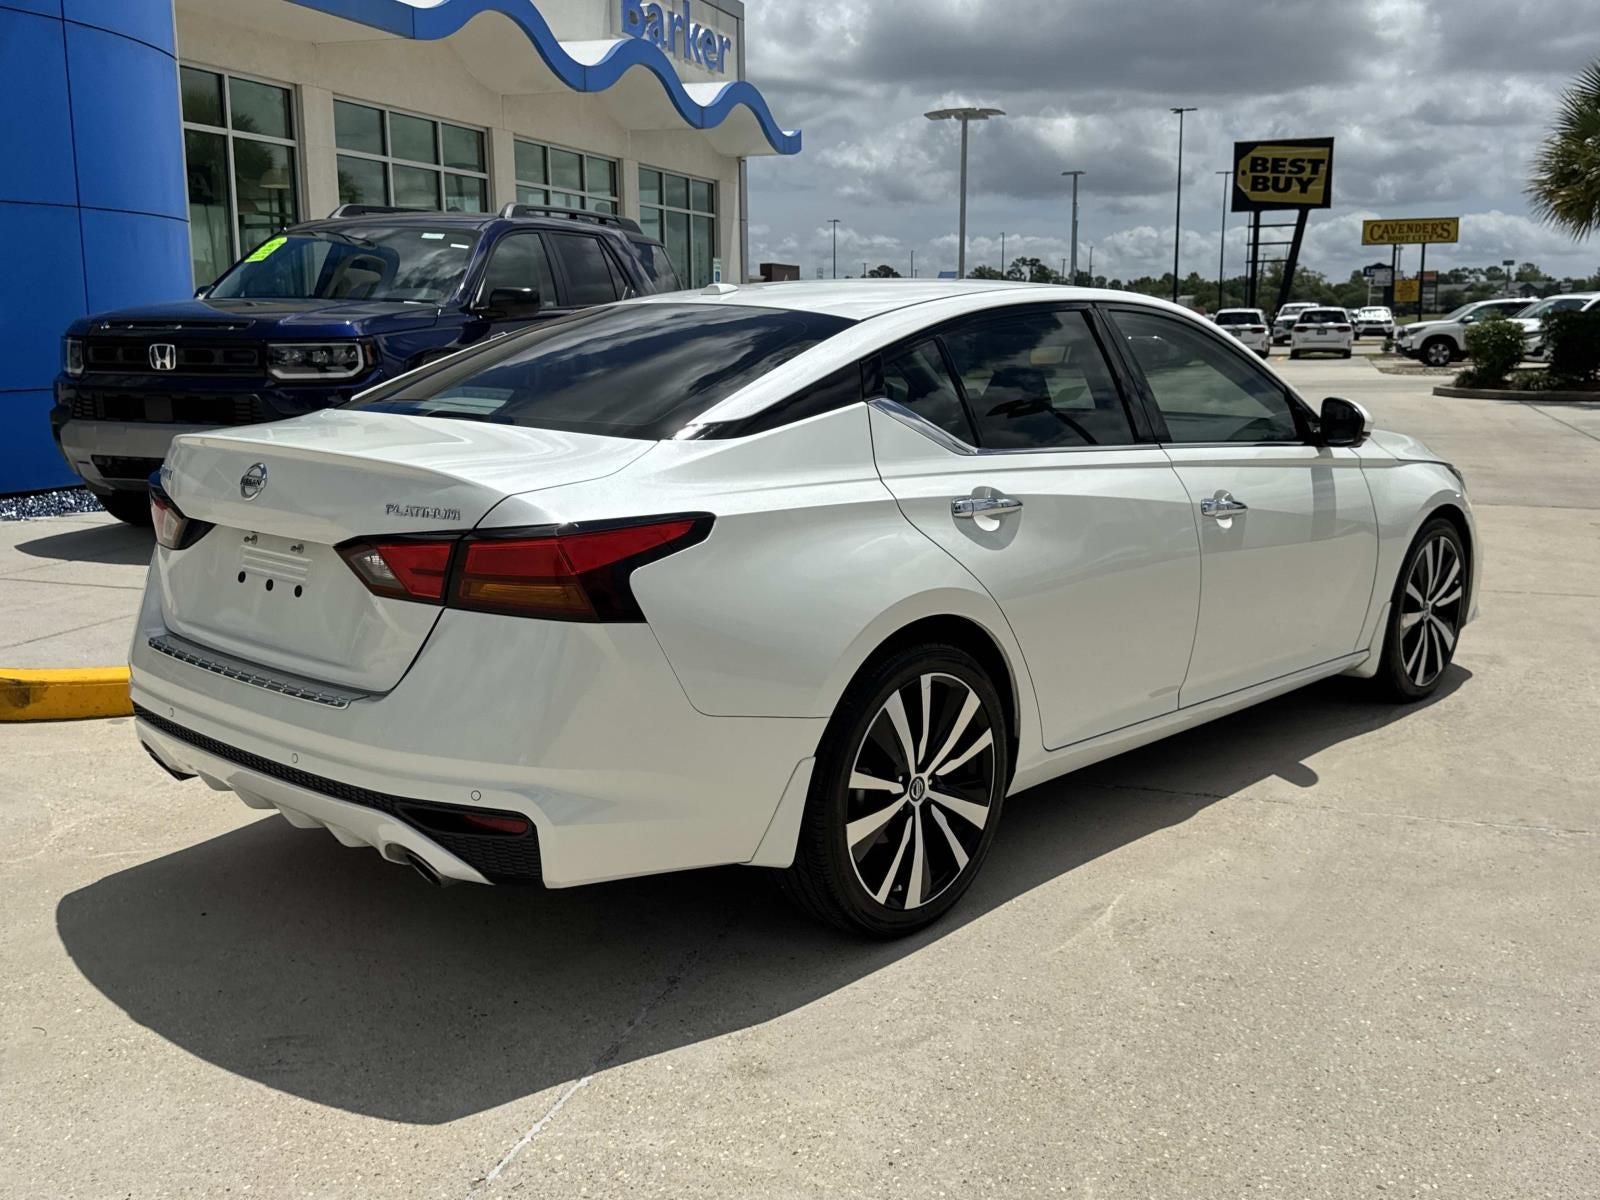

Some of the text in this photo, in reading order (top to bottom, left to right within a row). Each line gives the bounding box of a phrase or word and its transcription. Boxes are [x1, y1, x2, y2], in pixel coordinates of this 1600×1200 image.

[621, 0, 731, 74] Barker
[1249, 156, 1326, 175] BEST
[1250, 175, 1317, 194] BUY
[1412, 233, 1433, 241] CITY
[385, 503, 461, 520] PLATINUM
